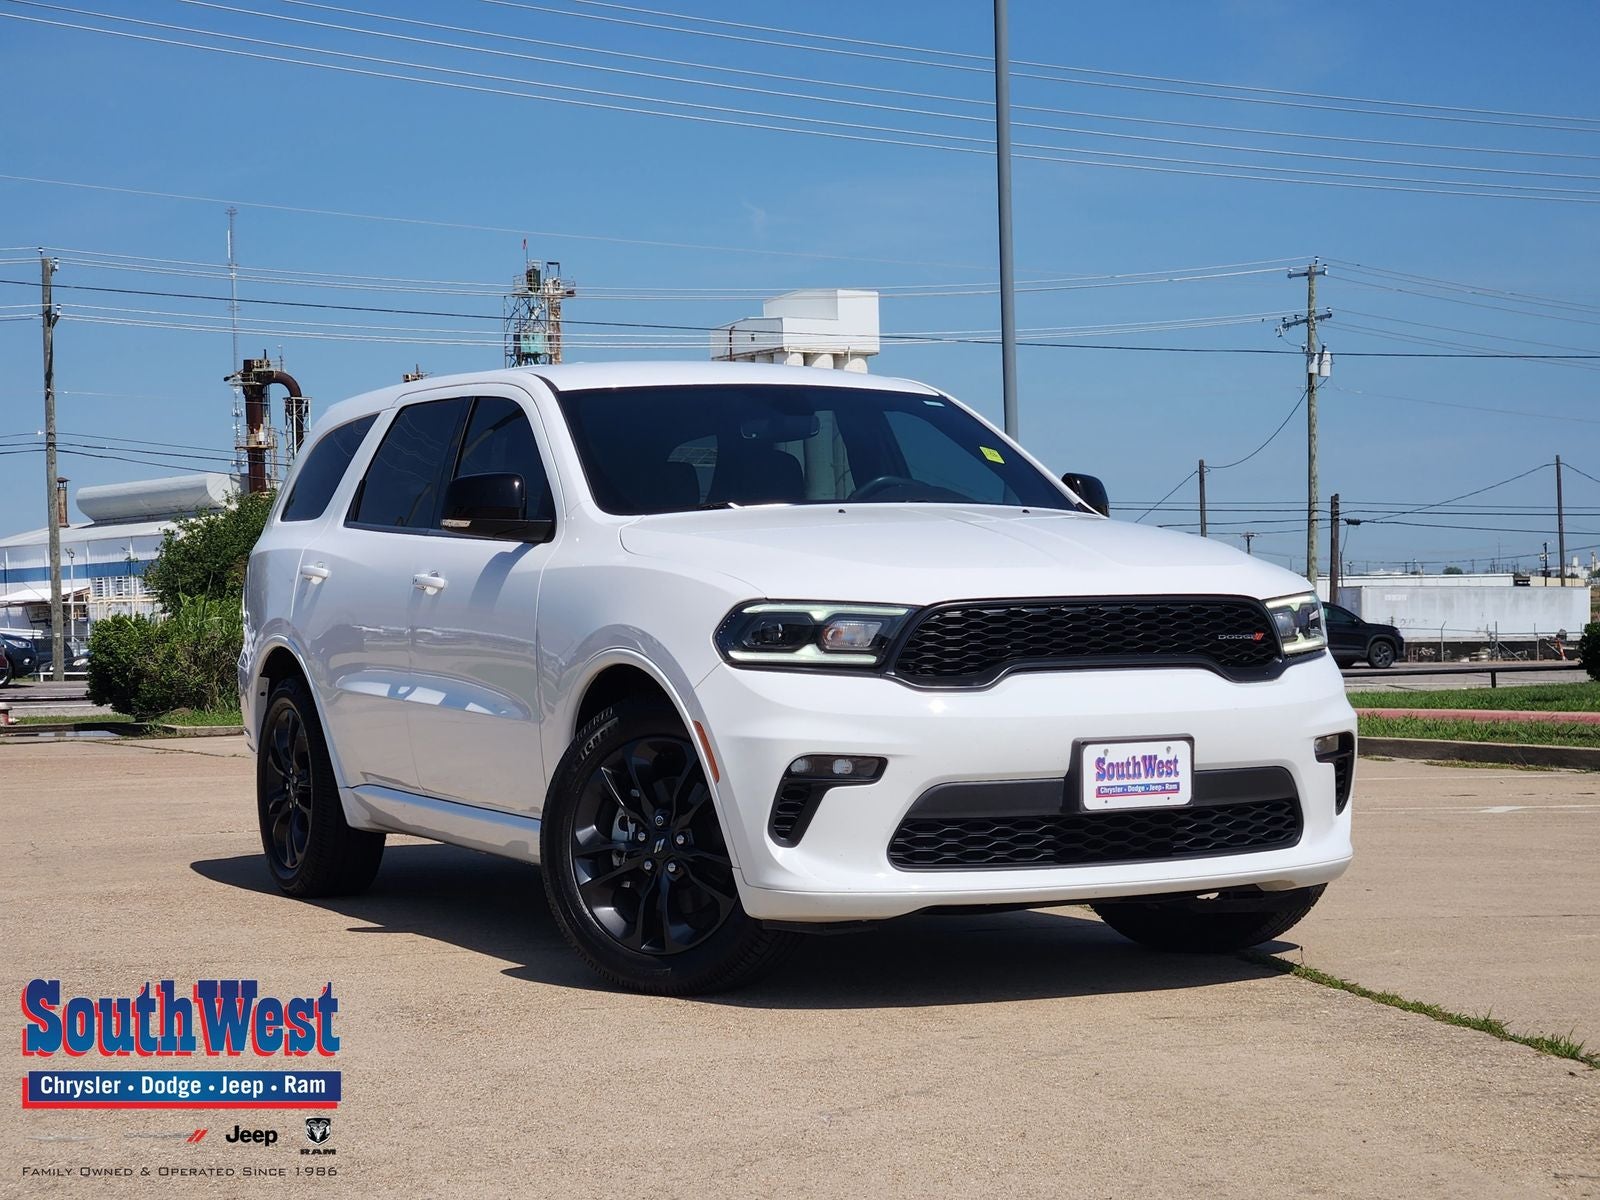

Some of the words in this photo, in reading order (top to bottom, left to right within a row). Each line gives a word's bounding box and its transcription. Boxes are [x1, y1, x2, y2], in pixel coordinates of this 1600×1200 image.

[1095, 754, 1179, 781] SouthWest
[1100, 786, 1123, 794] Chrysler
[1149, 783, 1161, 791] Jeep
[1165, 782, 1178, 790] Ram
